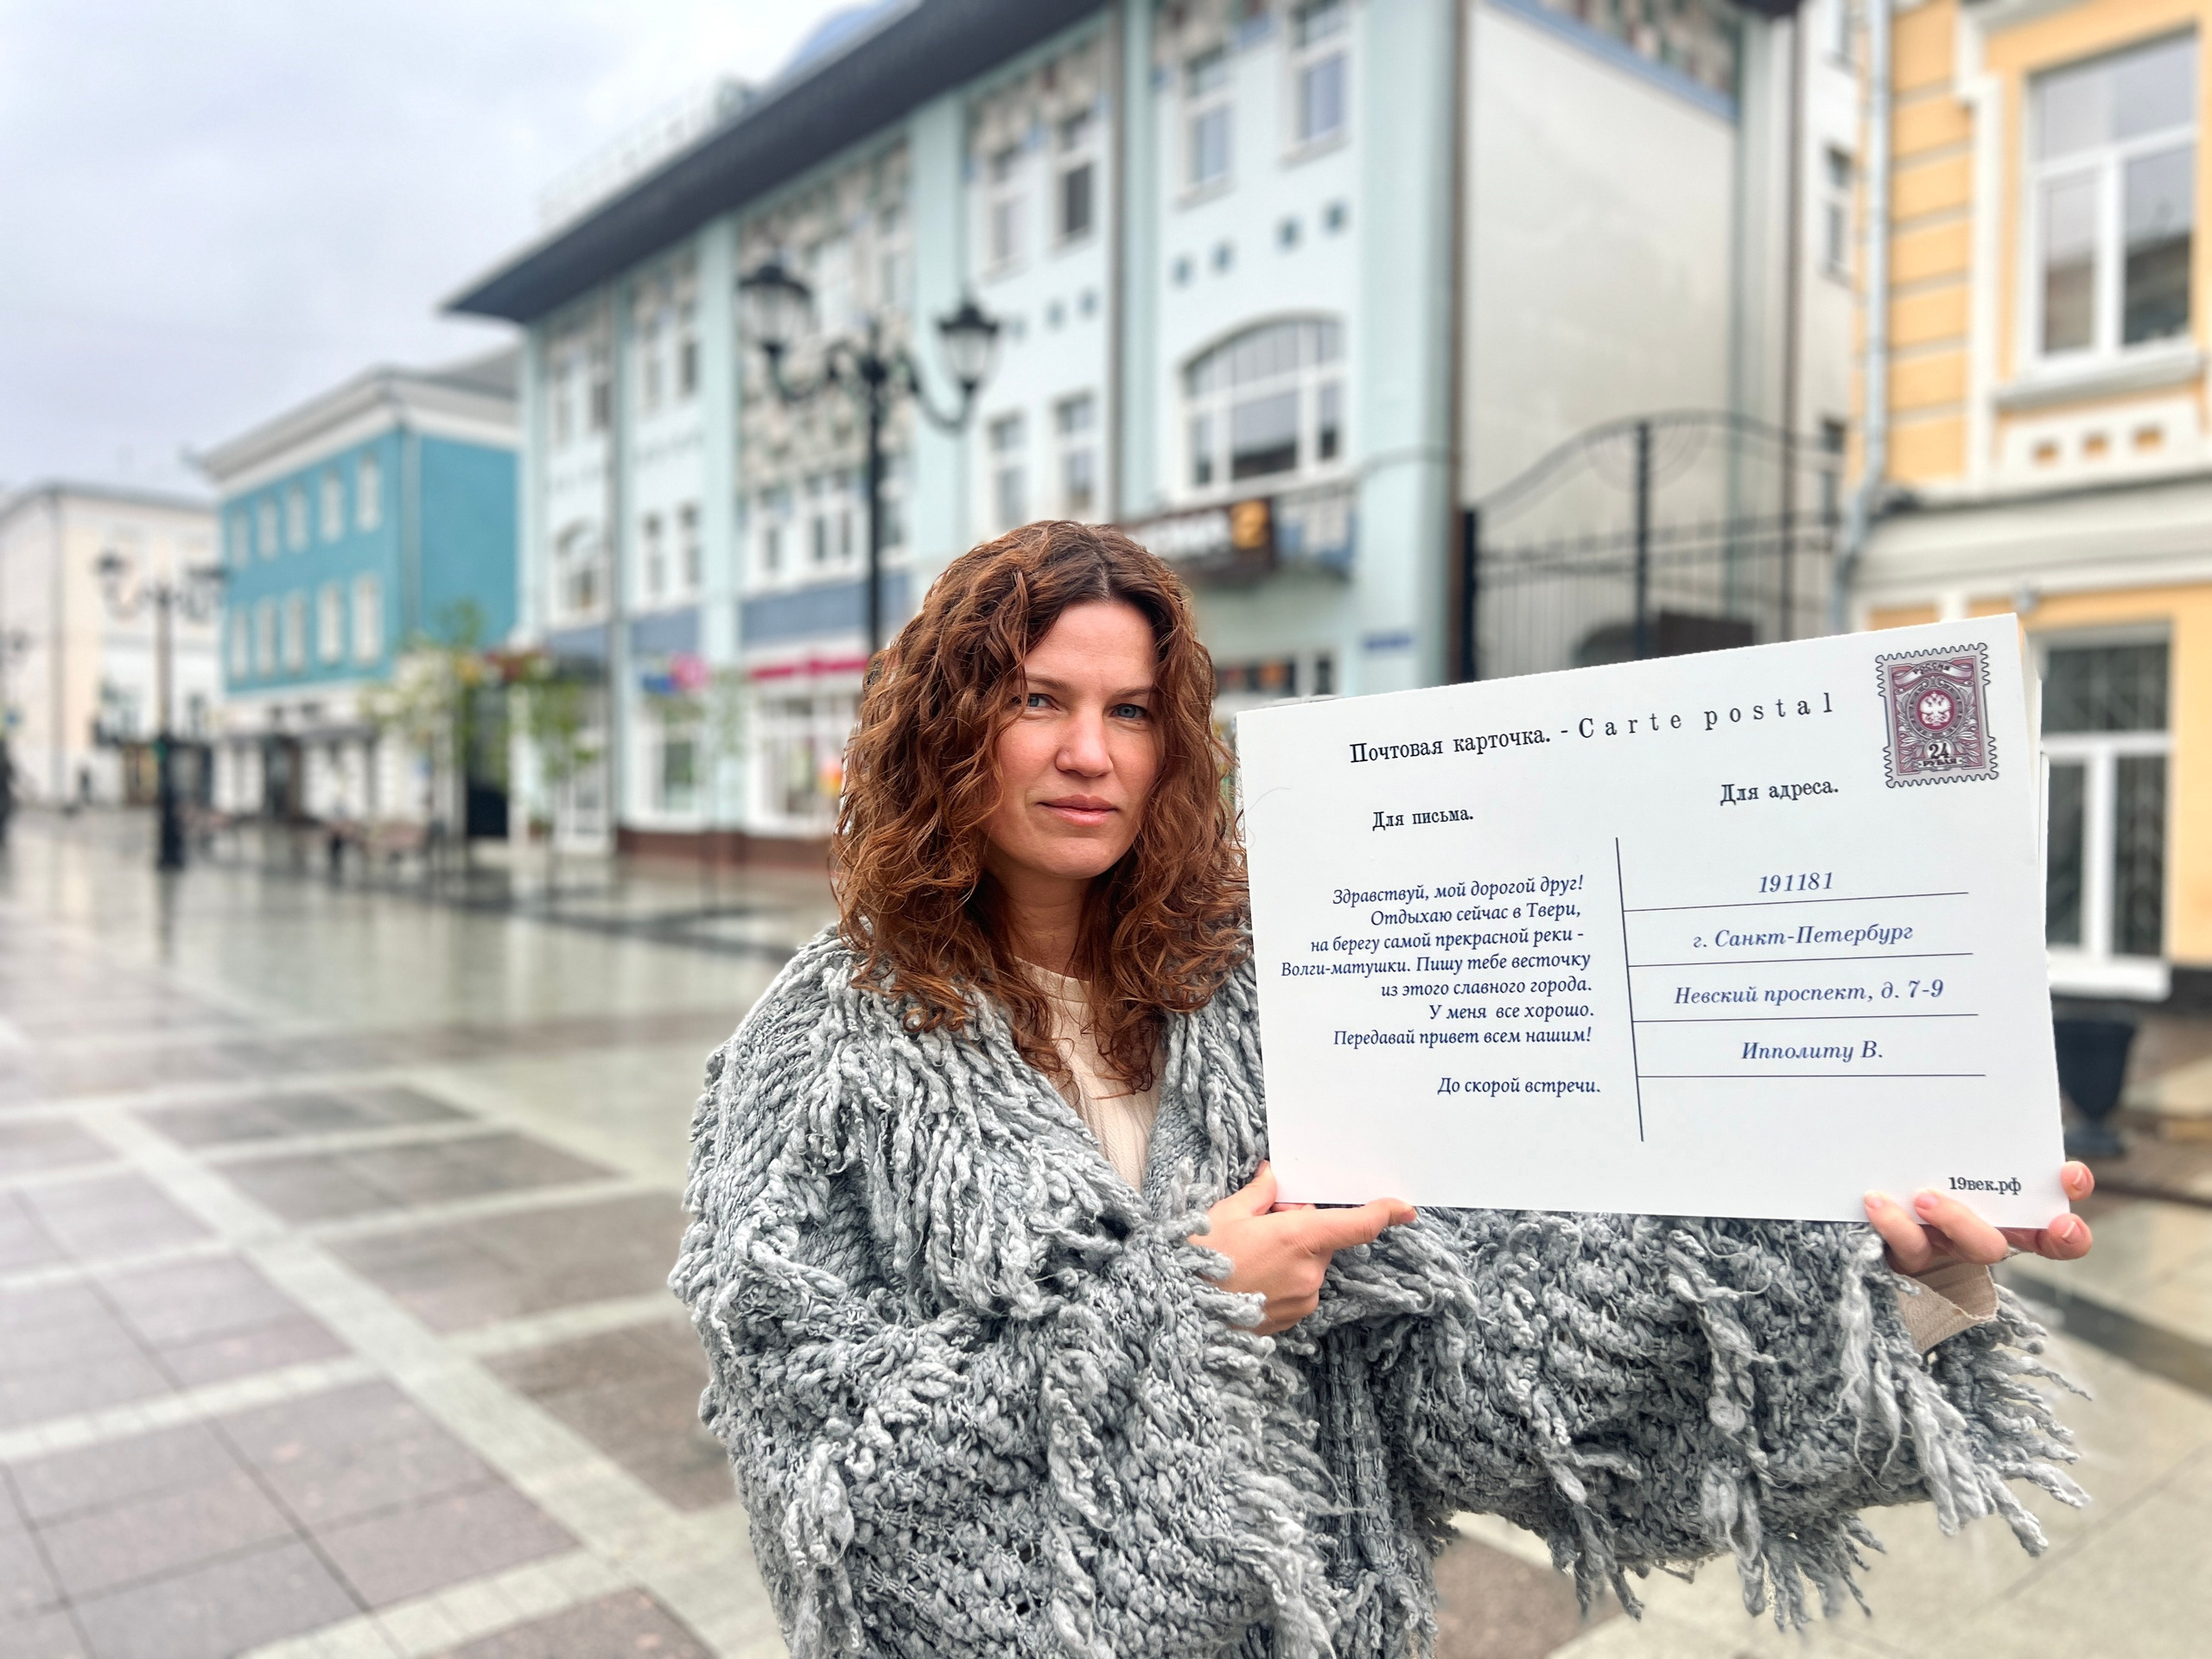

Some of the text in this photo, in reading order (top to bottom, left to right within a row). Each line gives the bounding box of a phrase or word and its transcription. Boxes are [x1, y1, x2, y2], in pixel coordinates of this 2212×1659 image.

[1911, 661, 1951, 675] РОССИЯ
[1349, 739, 1444, 764] Почтовая
[1452, 728, 1551, 755] карточка.
[1578, 712, 1682, 739] Carte
[1703, 690, 1834, 732] postal
[1923, 757, 1957, 767] РУБЛЯ
[1928, 742, 1950, 760] 24
[1719, 779, 1840, 807] Для адреса.
[1371, 808, 1474, 832] Для письма.
[1332, 873, 1584, 909] Здравствуй, мой дорогой друг!
[1758, 871, 1833, 893] 191181
[1370, 901, 1581, 926] Отдыхаю сейчас в Твери,
[1310, 939, 1330, 952] на
[1332, 934, 1381, 956] берегу
[1383, 931, 1432, 950] самой
[1434, 926, 1529, 952] прекрасной
[1532, 928, 1573, 948] реки
[1693, 922, 1913, 949] г. Санкт-Петербург
[1281, 951, 1592, 979] Волги-матушки. Пишу тебе весточку
[1381, 974, 1592, 998] из этого славного города.
[1673, 977, 1944, 1007] Невский проспект, д. 7-9
[1428, 1003, 1594, 1023] У меня все хорошо.
[1333, 1025, 1592, 1050] Передавай привет всем нашим!
[1740, 1039, 1884, 1064] Ипполиту В.
[1436, 1076, 1601, 1098] До скорой встречи.
[1948, 1175, 2022, 1196] 19век.рф
